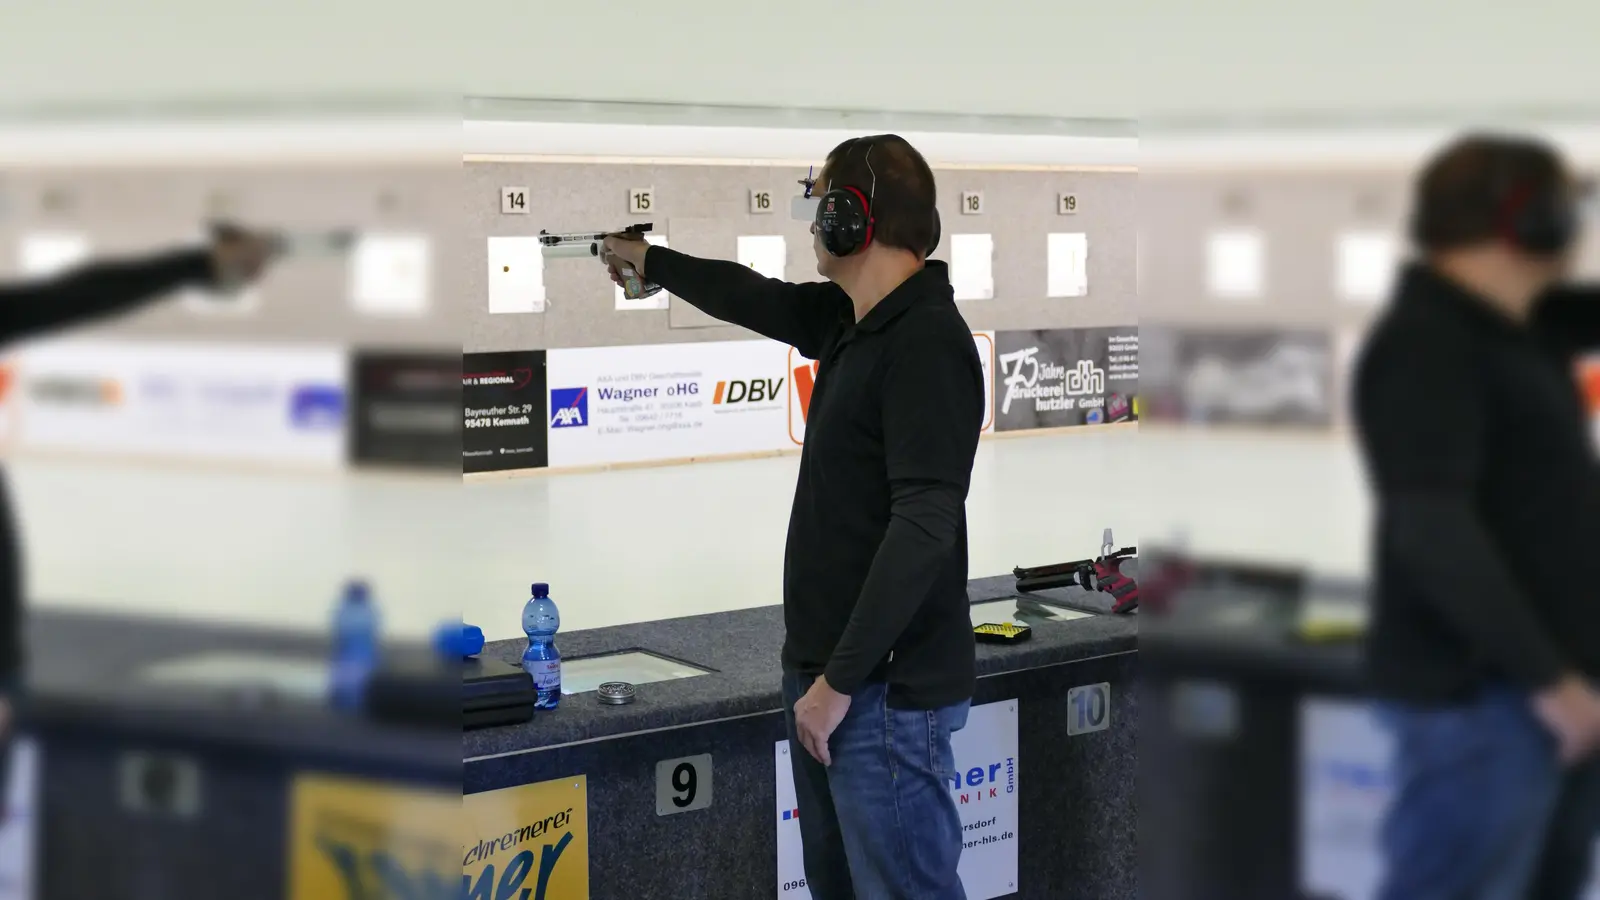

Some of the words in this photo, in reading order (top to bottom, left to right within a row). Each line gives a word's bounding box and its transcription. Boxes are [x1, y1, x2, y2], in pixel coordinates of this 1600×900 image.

[506, 192, 525, 209] 14
[634, 192, 650, 210] 15
[755, 192, 770, 209] 16
[966, 195, 980, 211] 18
[1063, 195, 1076, 210] 19
[480, 376, 514, 385] REGIONAL
[999, 346, 1039, 415] 75
[1039, 362, 1065, 381] Jahre
[597, 387, 659, 402] Wagner
[666, 382, 699, 396] oHG
[726, 377, 784, 404] DBV
[1012, 381, 1065, 400] druckerei
[464, 406, 506, 418] Bayreuther
[508, 405, 521, 415] Str.
[522, 404, 532, 414] 29
[1035, 396, 1075, 412] hutzler
[1078, 397, 1105, 409] GmbH
[464, 418, 491, 428] 95478
[493, 416, 529, 427] Kemnath
[551, 407, 587, 428] AXA
[1071, 686, 1106, 730] 10
[1006, 757, 1014, 794] GmbH
[671, 762, 697, 808] 9
[463, 807, 573, 866] chreinerei
[783, 878, 809, 891] 096
